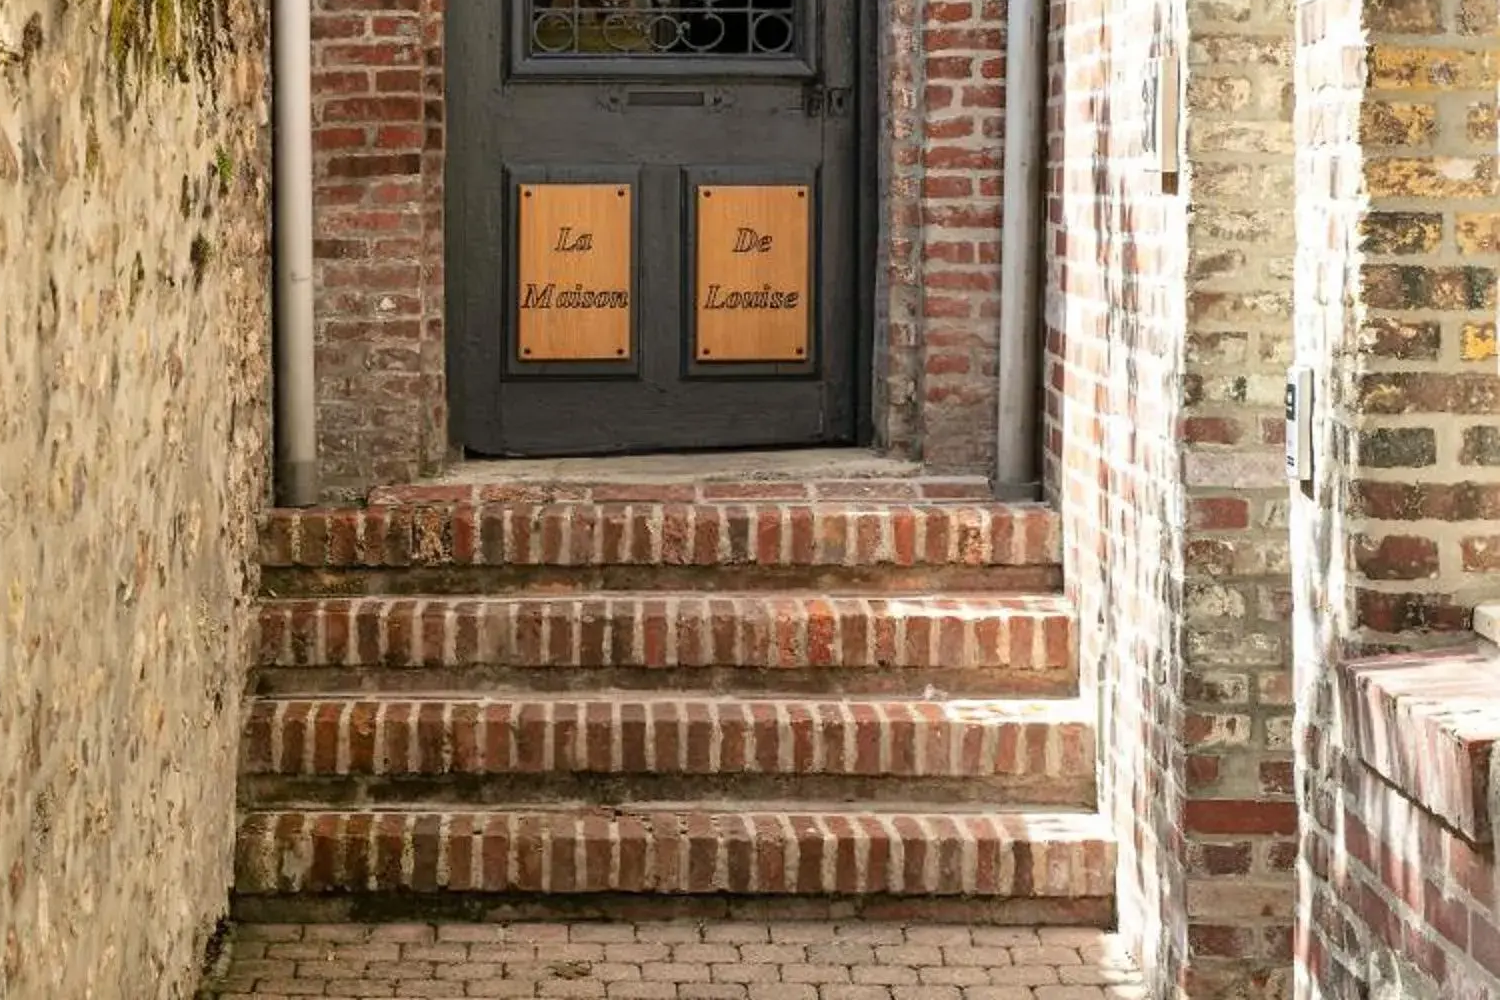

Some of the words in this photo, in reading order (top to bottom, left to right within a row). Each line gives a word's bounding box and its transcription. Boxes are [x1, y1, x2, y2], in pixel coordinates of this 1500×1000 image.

[554, 227, 593, 251] La
[732, 226, 773, 253] De
[521, 284, 629, 310] Maison
[704, 284, 800, 310] Louise
